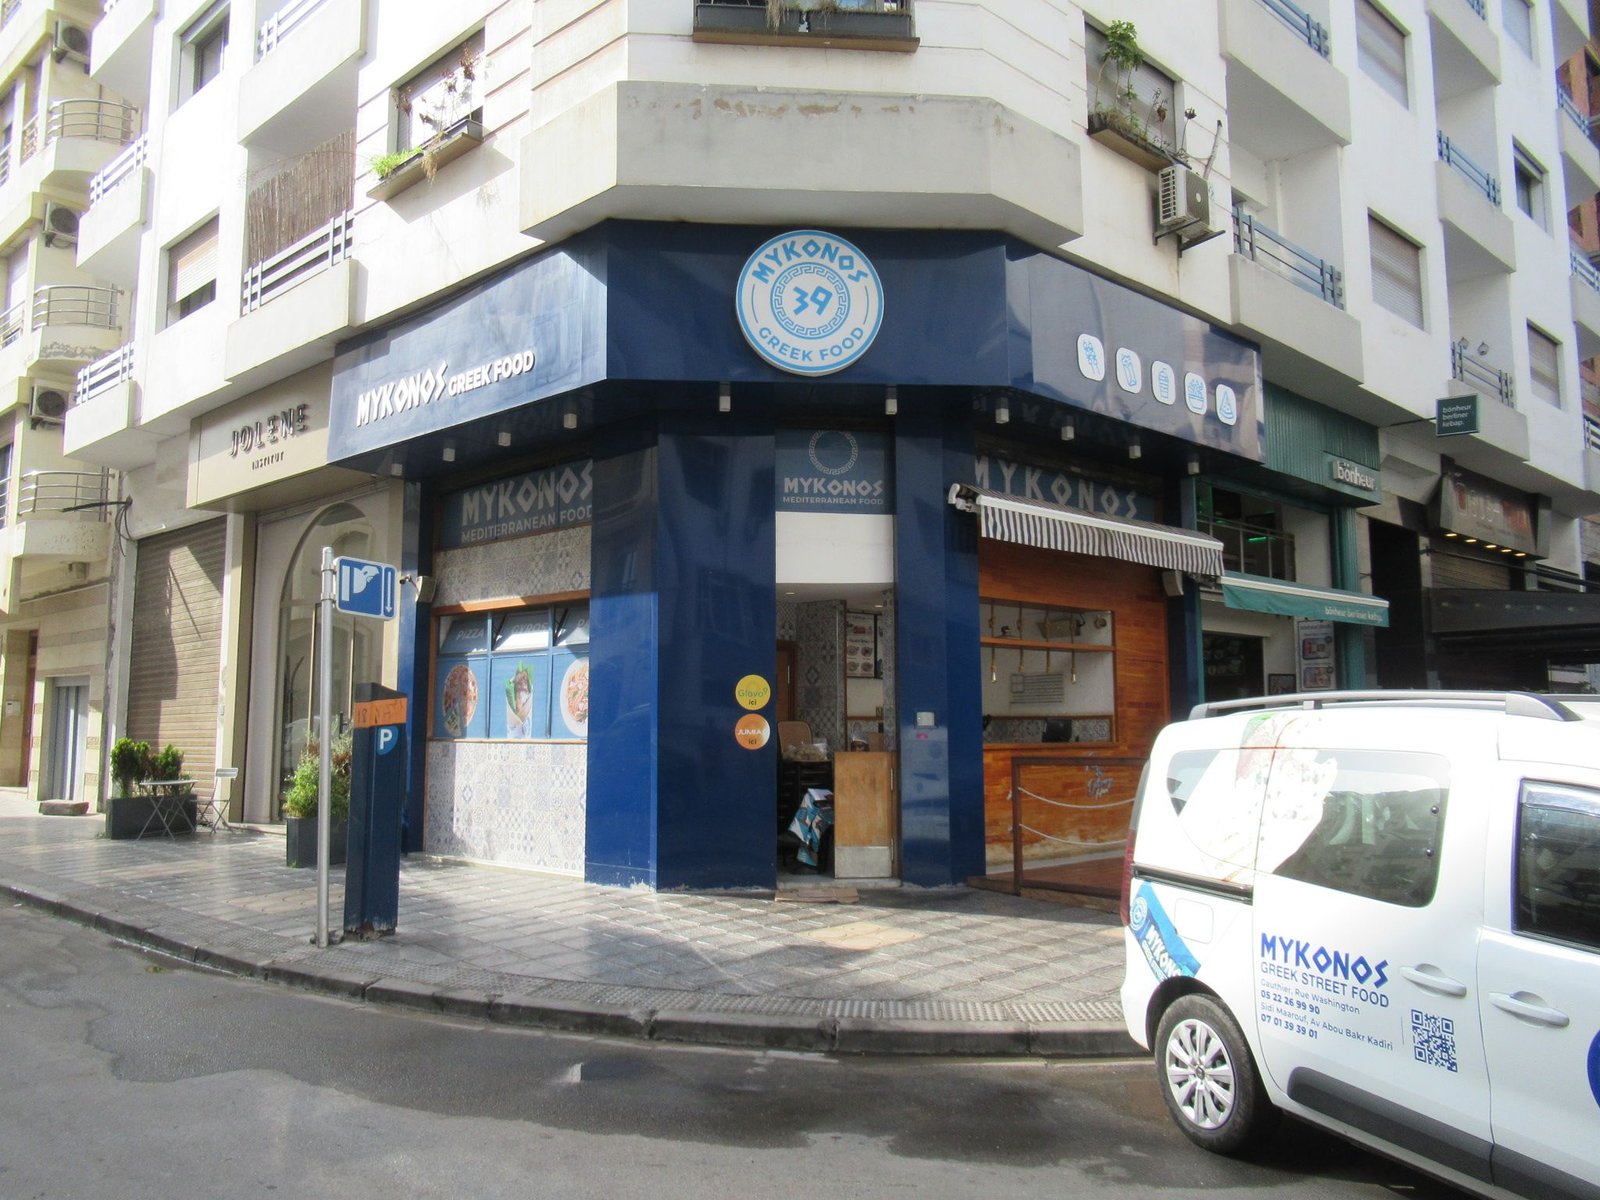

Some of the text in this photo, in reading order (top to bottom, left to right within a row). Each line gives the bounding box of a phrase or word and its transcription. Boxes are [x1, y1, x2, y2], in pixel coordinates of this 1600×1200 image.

[752, 240, 868, 284] MYKONOS
[793, 286, 833, 316] 39
[759, 327, 864, 362] GREEK FOOD
[356, 351, 536, 427] MYKONOS GREEK FOOD
[230, 403, 309, 457] JOLENE
[462, 459, 593, 526] MYKONOS
[783, 496, 857, 505] MEDITERRANEAN
[784, 478, 884, 497] MYKONOS
[975, 455, 1138, 519] MYKONOS
[461, 512, 556, 544] MEDITERRANEAN
[456, 628, 484, 641] PIZZA
[380, 728, 393, 750] P
[1261, 932, 1389, 989] MYKONOS
[1261, 961, 1389, 1008] GREEK STREET FOOD
[1261, 989, 1320, 1015] 05 22 26 99 90
[1295, 988, 1310, 1000] Rue
[1311, 993, 1360, 1015] Washington
[1261, 1001, 1274, 1011] Sidi
[1310, 1018, 1320, 1028] Av
[1322, 1021, 1344, 1035] Abou
[1345, 1028, 1365, 1041] Bakr
[1367, 1035, 1393, 1051] Kadiri
[1261, 1013, 1318, 1039] 07 01 39 39 01
